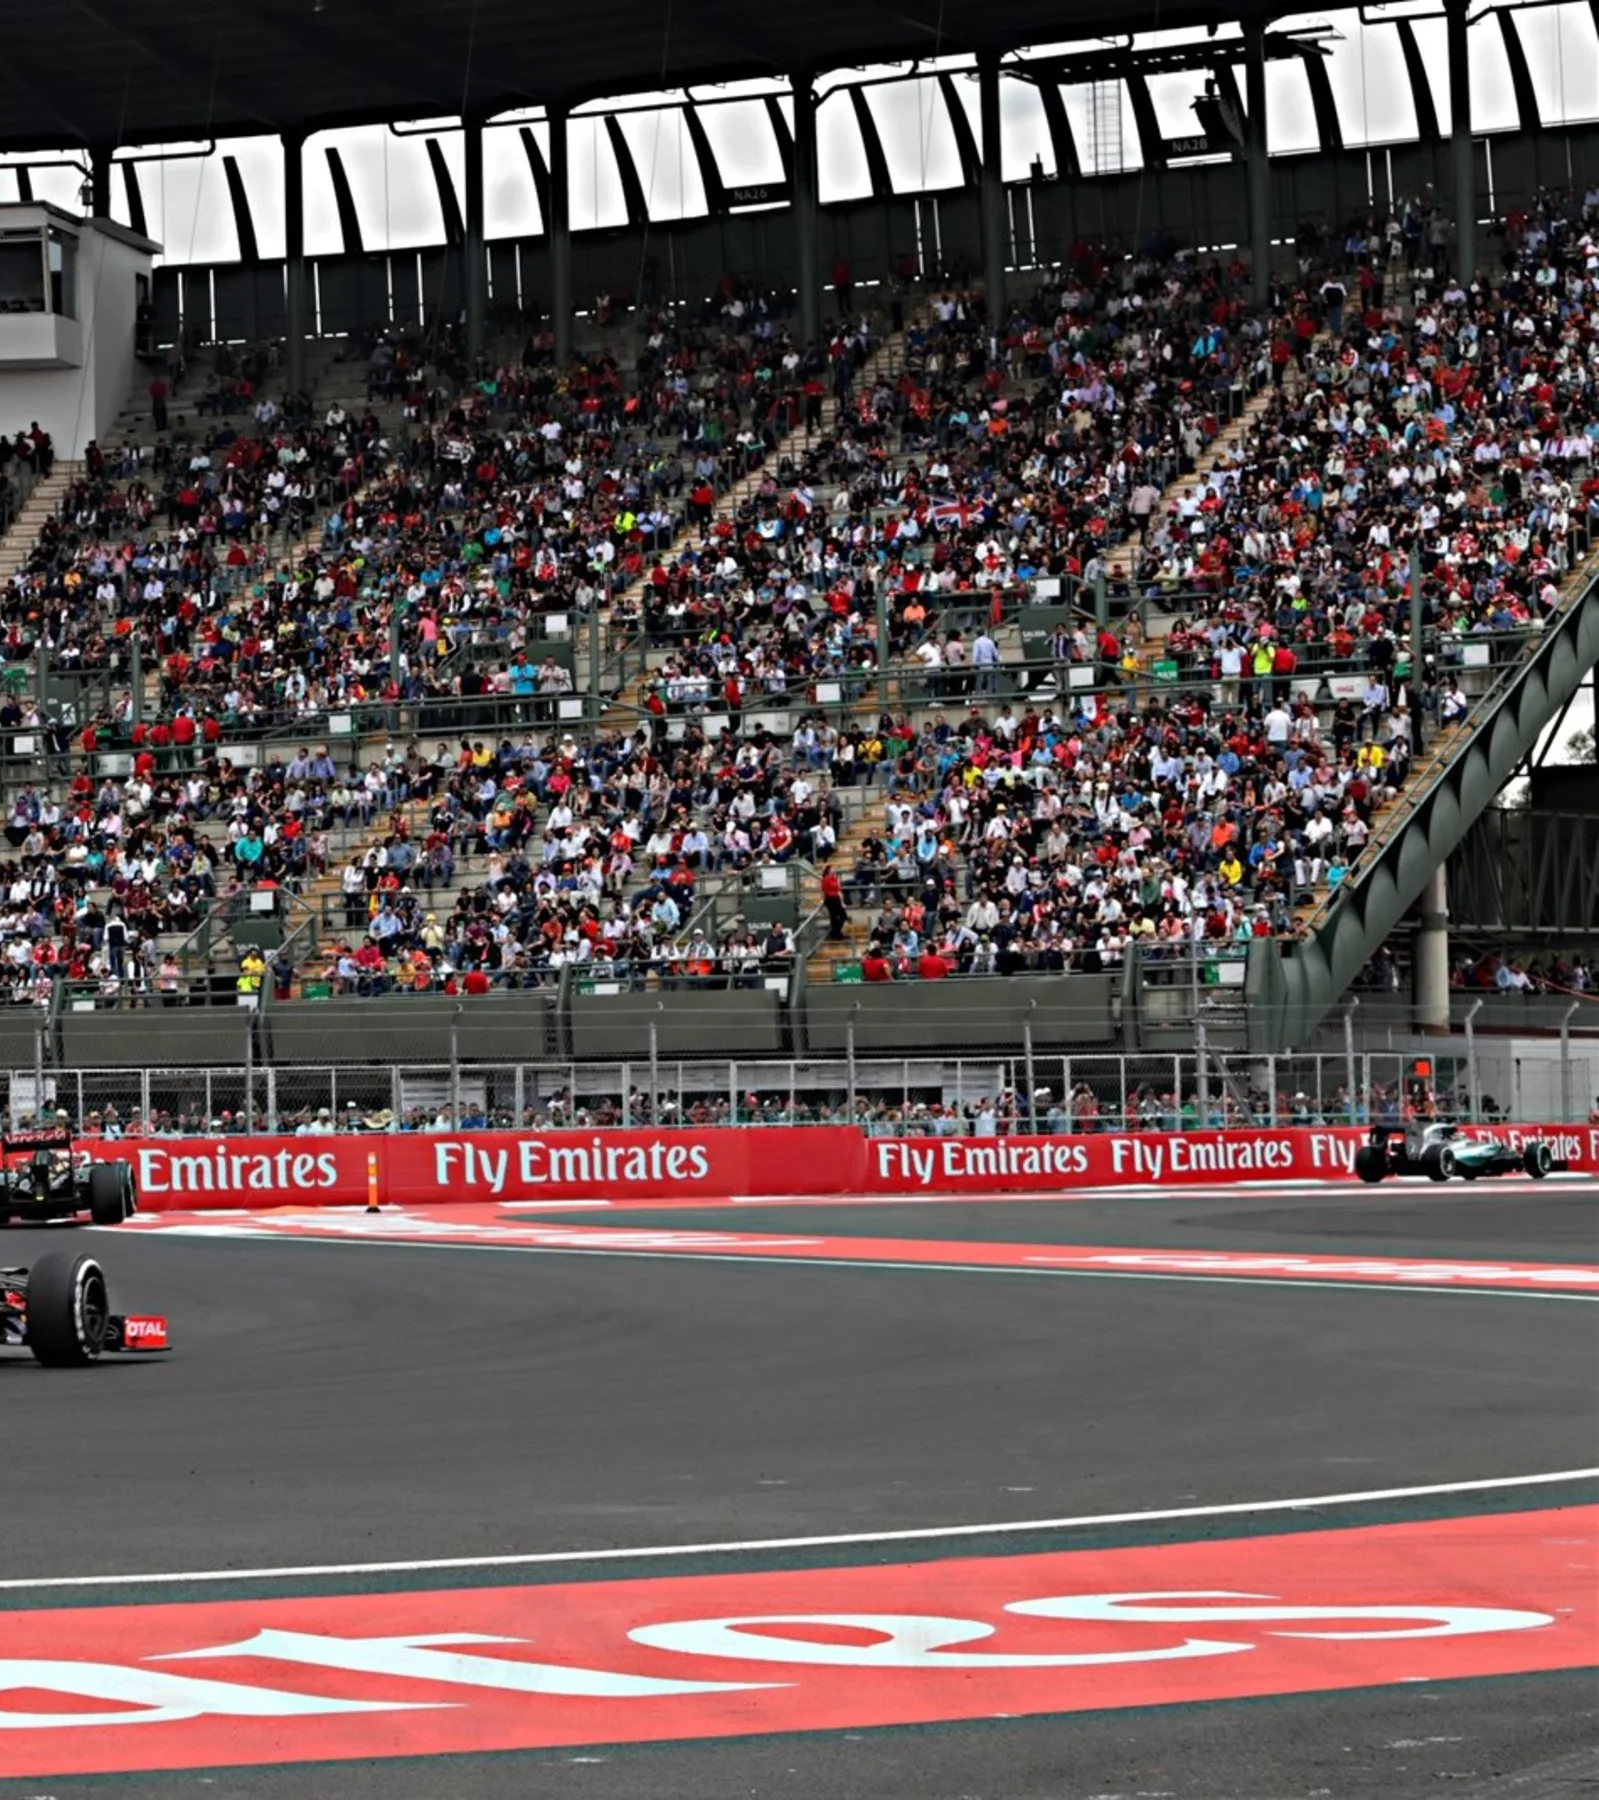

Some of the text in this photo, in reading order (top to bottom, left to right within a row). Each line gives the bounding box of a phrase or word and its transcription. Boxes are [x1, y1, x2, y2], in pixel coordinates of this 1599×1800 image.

[137, 1144, 337, 1192] Emirates
[434, 1138, 709, 1194] Fly Emirates
[877, 1140, 1088, 1184] Fly Emirates
[1111, 1135, 1293, 1180] Fly Emirates
[1310, 1134, 1356, 1174] Fly
